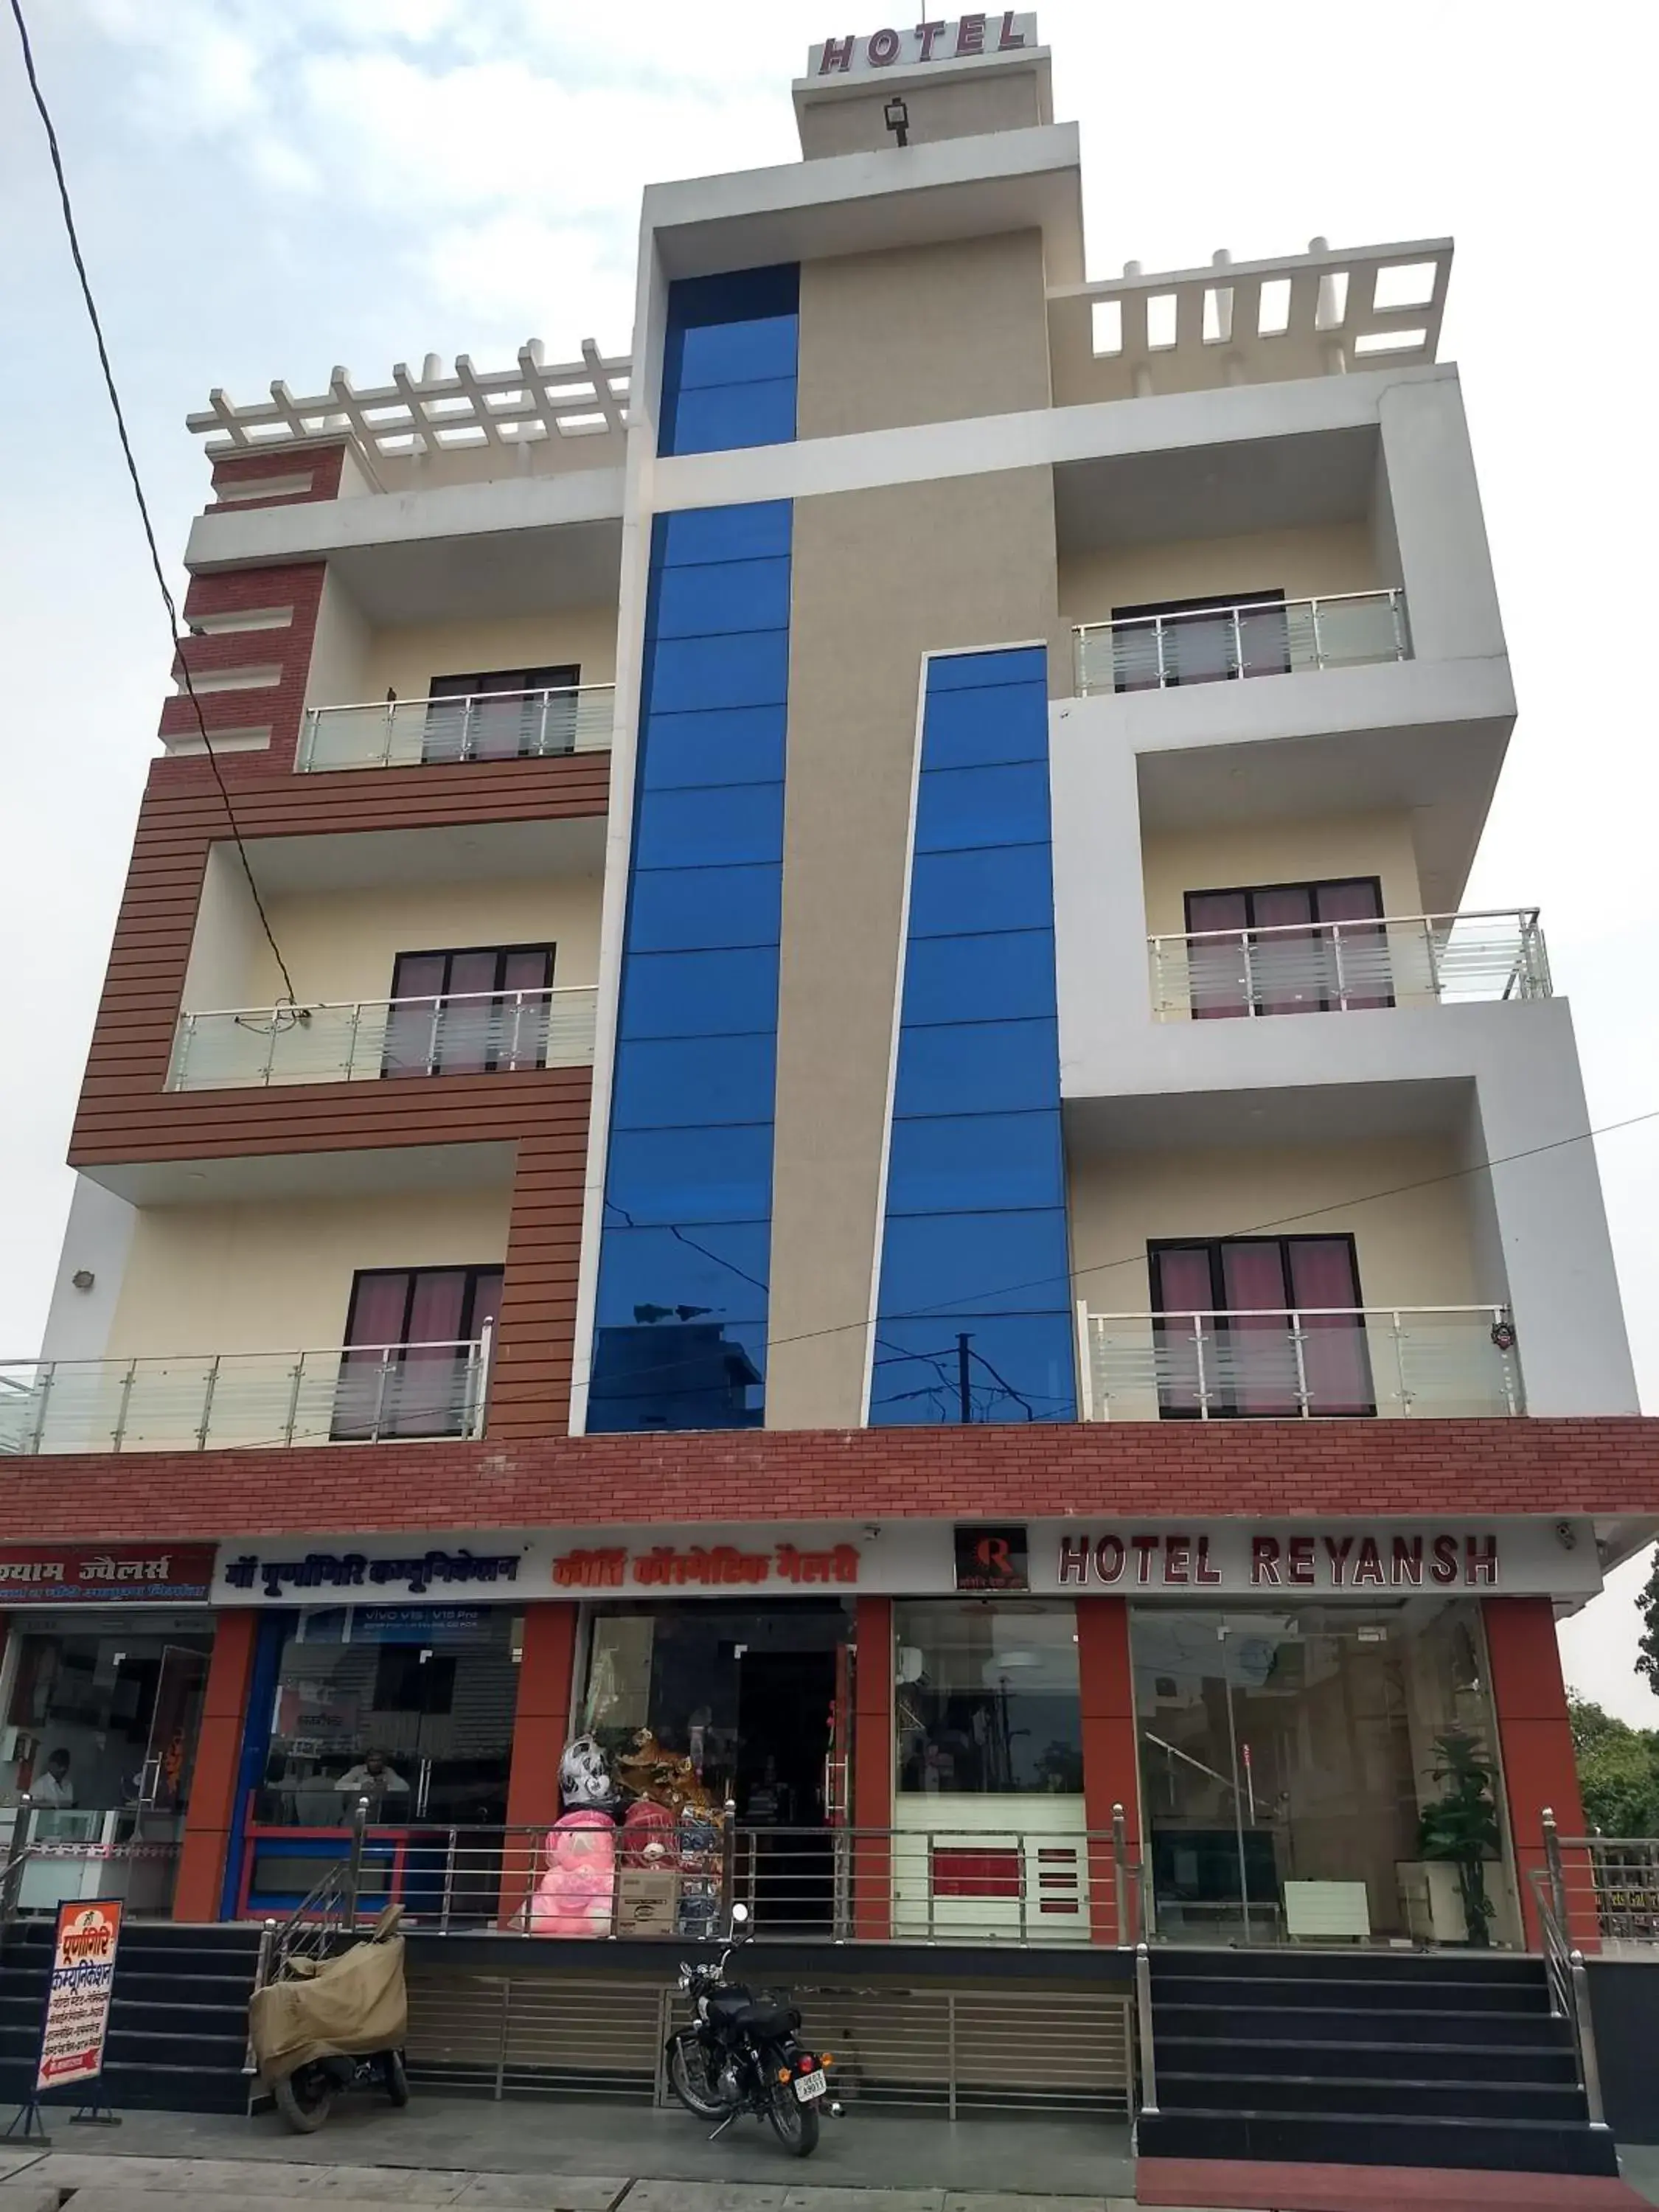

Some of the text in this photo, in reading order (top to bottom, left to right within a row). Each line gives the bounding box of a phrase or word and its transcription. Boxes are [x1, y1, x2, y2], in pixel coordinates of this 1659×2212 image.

[818, 11, 1025, 74] HOTEL
[1058, 1534, 1499, 1585] HOTEL REYANSH
